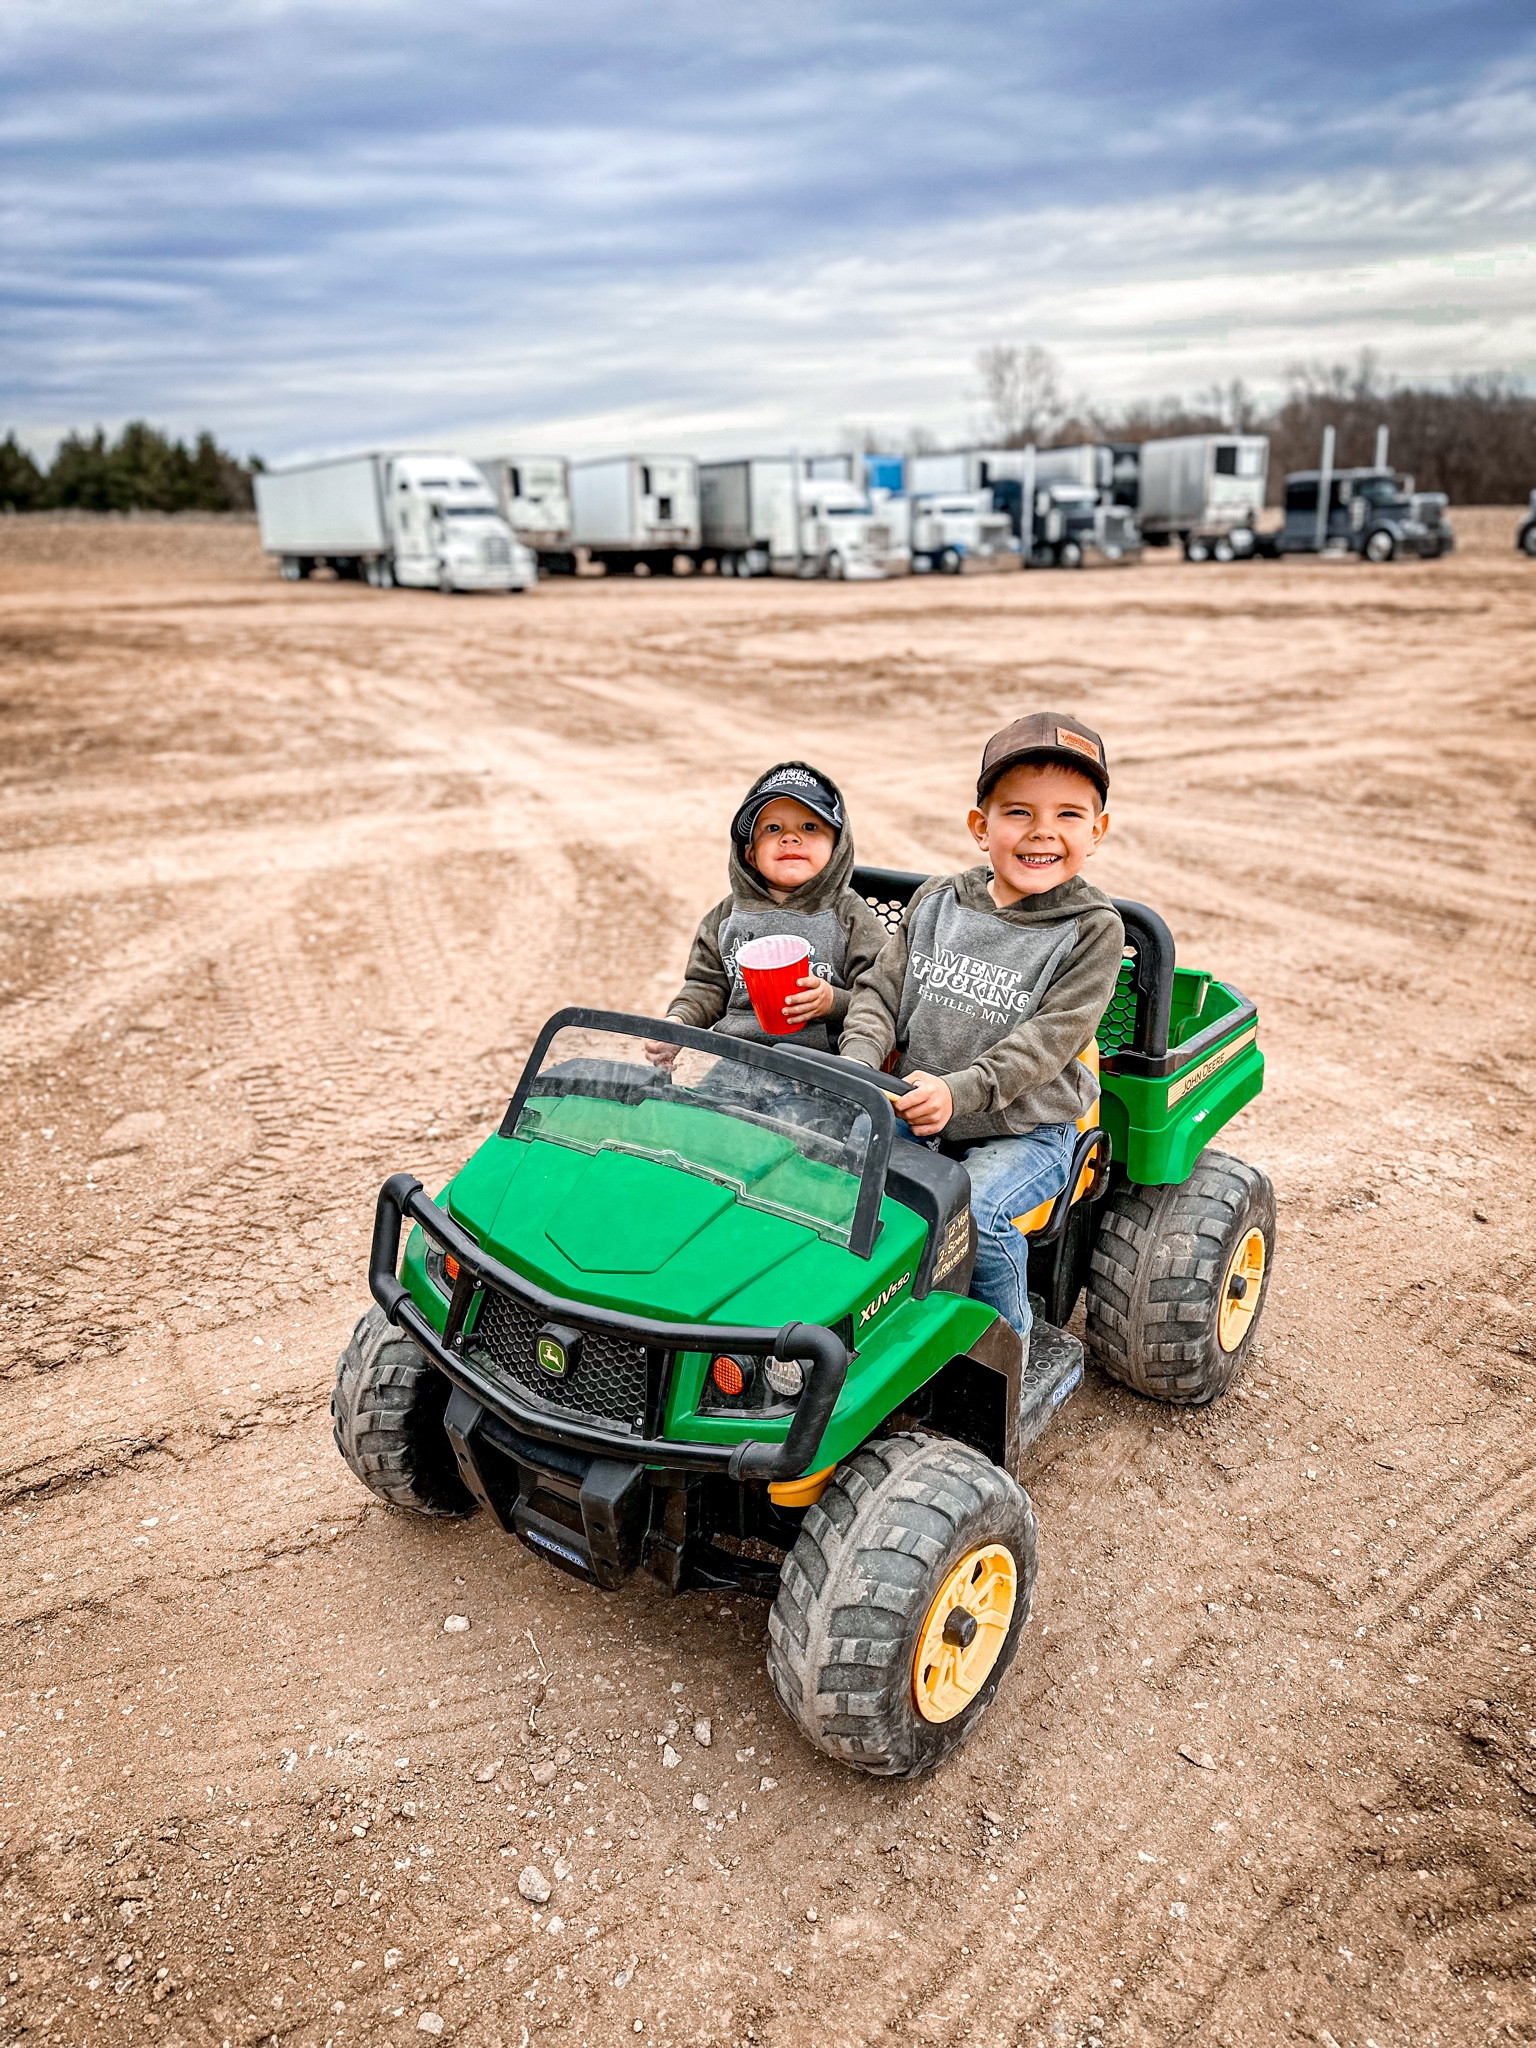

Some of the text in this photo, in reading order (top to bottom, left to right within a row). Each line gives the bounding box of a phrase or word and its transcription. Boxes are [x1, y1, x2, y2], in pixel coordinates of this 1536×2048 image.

[934, 942, 1022, 989] MENT
[980, 1008, 1010, 1025] MN
[1181, 1052, 1225, 1095] JOHN DEERE
[858, 1271, 910, 1328] XUV550
